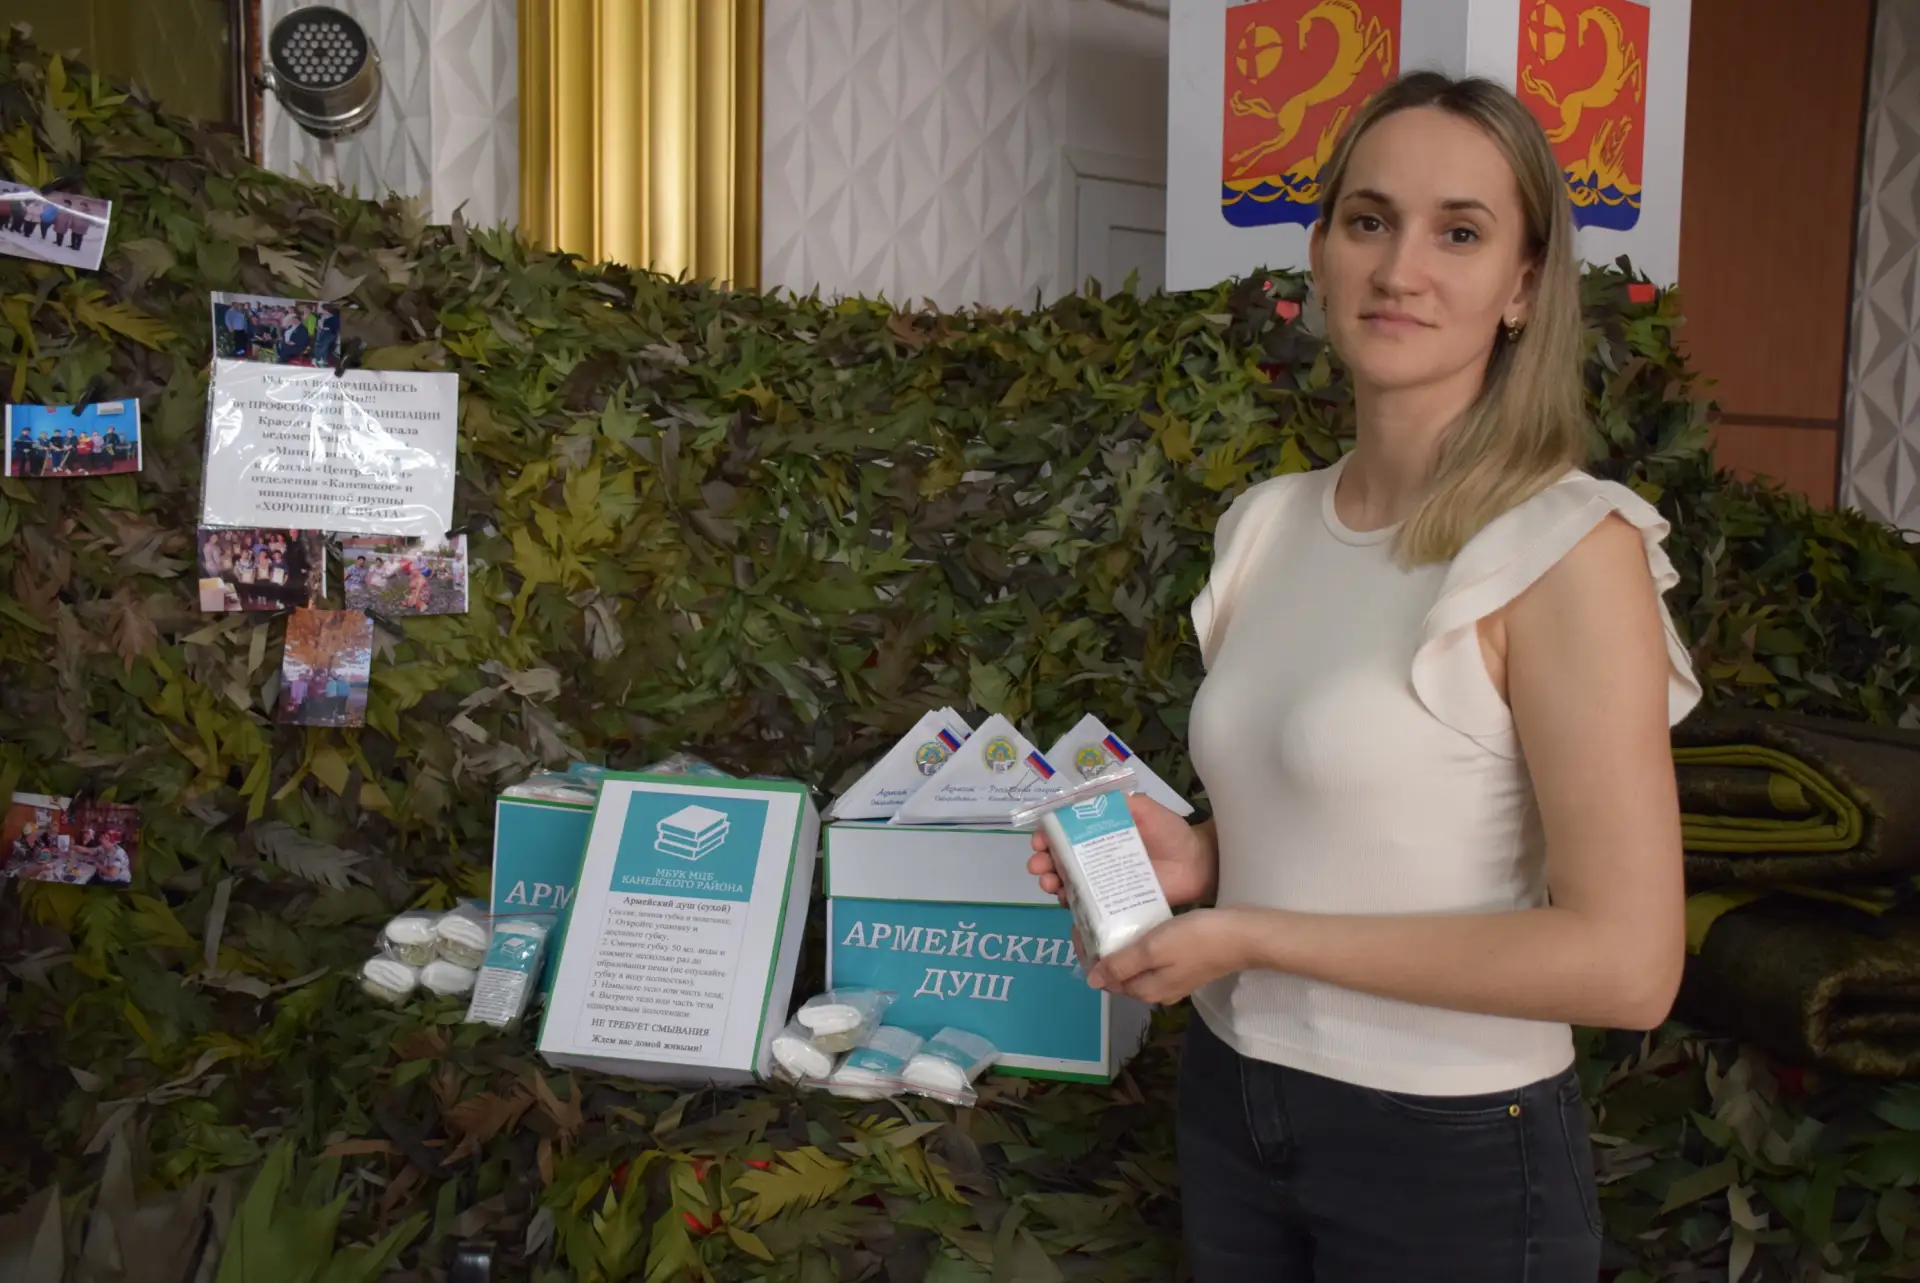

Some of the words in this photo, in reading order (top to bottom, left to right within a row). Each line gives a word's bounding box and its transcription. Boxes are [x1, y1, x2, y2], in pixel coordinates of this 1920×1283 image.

[622, 874, 694, 889] КАНЕВСКОГО
[696, 880, 744, 893] РАЙОНА
[655, 868, 687, 880] МБУК
[688, 870, 715, 882] МЦБ
[623, 896, 674, 908] Армейский
[675, 902, 695, 911] душ
[697, 902, 731, 915] (сухой)
[615, 918, 653, 929] Откройте
[913, 967, 1015, 1002] ДУШ
[591, 1017, 605, 1027] НЕ
[607, 1019, 650, 1032] ТРЕБУЕТ
[651, 1023, 710, 1037] СМЫВАНИЯ
[618, 1038, 633, 1046] вас
[634, 1038, 661, 1049] домой
[663, 1042, 703, 1053] живыми!
